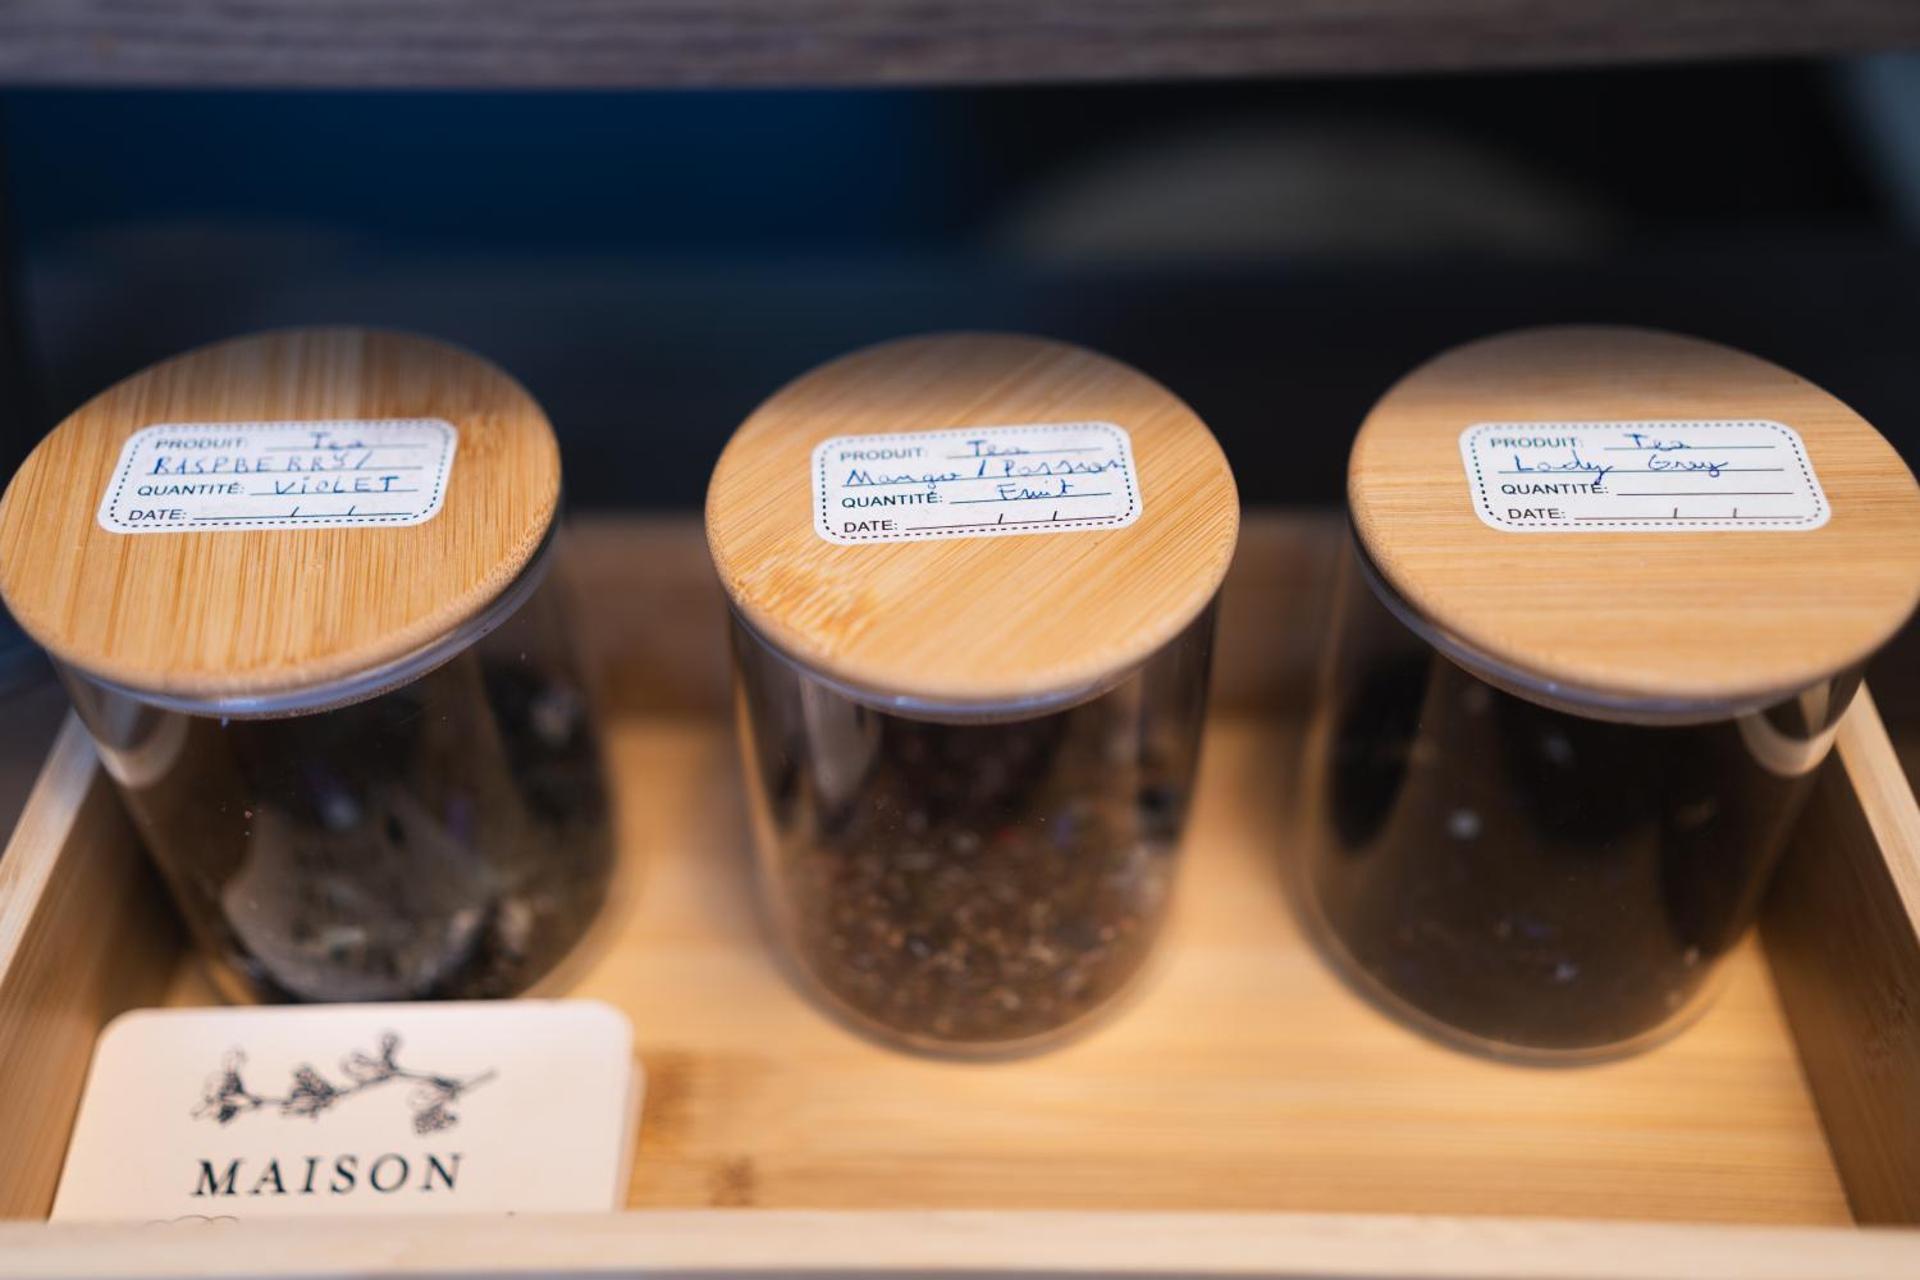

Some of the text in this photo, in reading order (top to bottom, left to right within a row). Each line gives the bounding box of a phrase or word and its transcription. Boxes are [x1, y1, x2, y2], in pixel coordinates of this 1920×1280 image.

[966, 440, 1029, 457] Tea
[1623, 433, 1691, 451] Tea
[1514, 449, 1613, 485] Lady
[137, 482, 245, 497] QUANTITÉ:
[841, 478, 1074, 509] QUANTITÉ: Fruit
[128, 509, 187, 522] DATE:
[1508, 508, 1566, 519] DATE:
[844, 520, 899, 534] DATE:
[192, 1151, 464, 1197] MAISON
